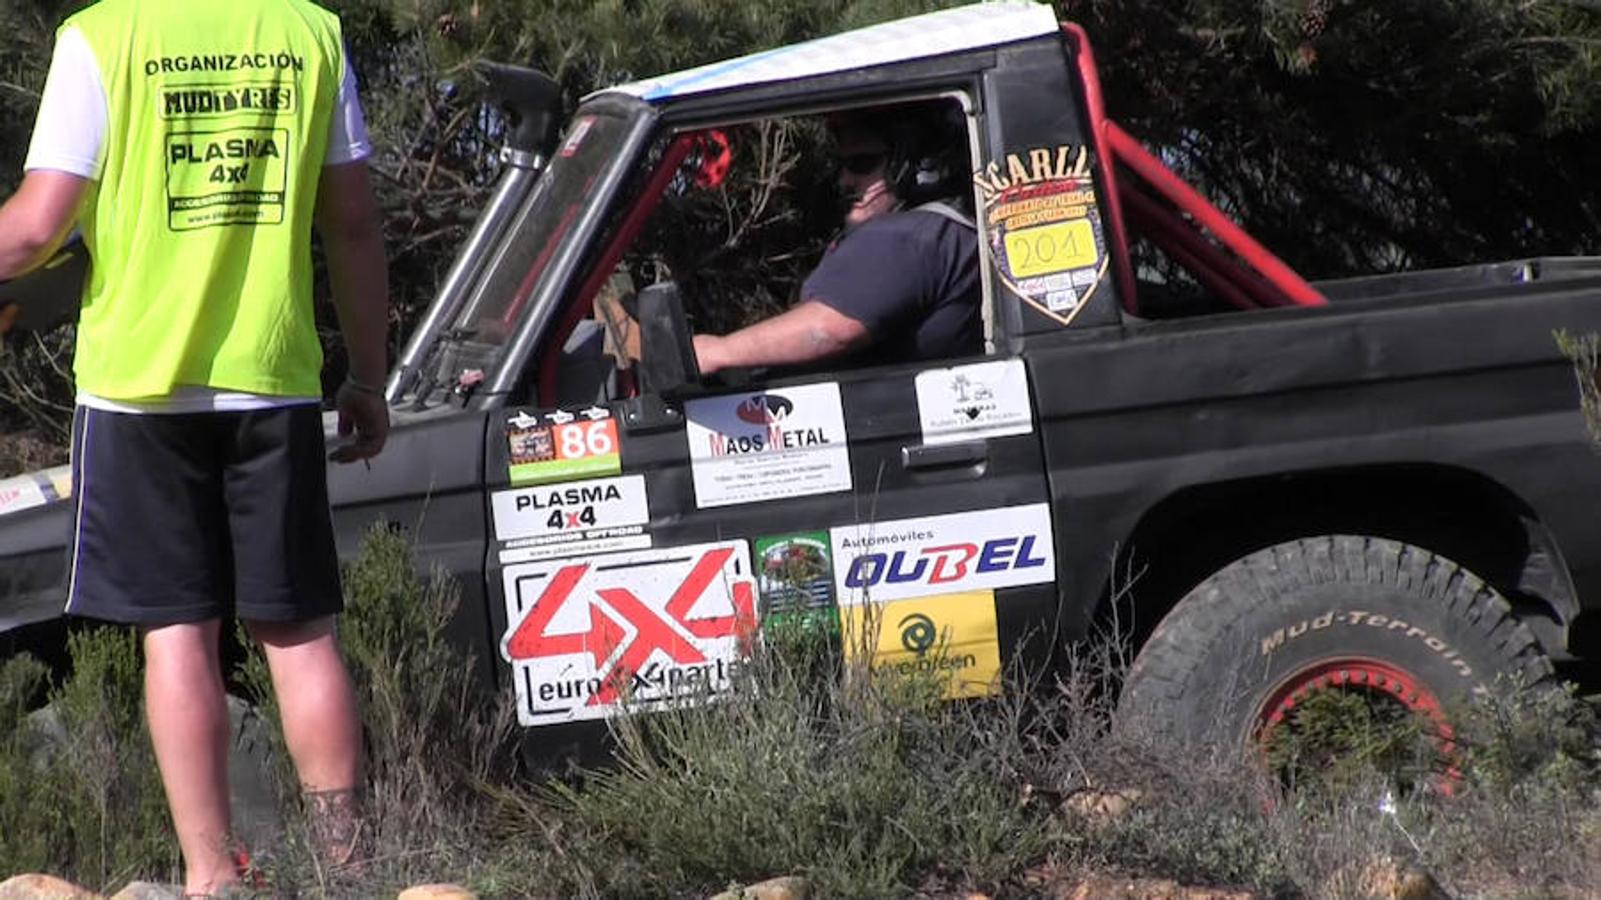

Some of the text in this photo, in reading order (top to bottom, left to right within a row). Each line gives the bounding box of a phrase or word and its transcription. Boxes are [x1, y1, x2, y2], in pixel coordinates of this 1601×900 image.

[145, 51, 303, 76] ORGANIZACIÓN
[170, 138, 279, 165] PLASMA
[1013, 230, 1081, 270] 201
[561, 422, 612, 460] 86
[709, 432, 764, 460] MAOS
[768, 425, 830, 452] METAL
[516, 485, 621, 511] PLASMA
[547, 506, 597, 530] 4x4
[842, 530, 934, 549] Automóviles
[845, 535, 1046, 588] OUBEL
[1261, 611, 1472, 677] Mud-Terrain
